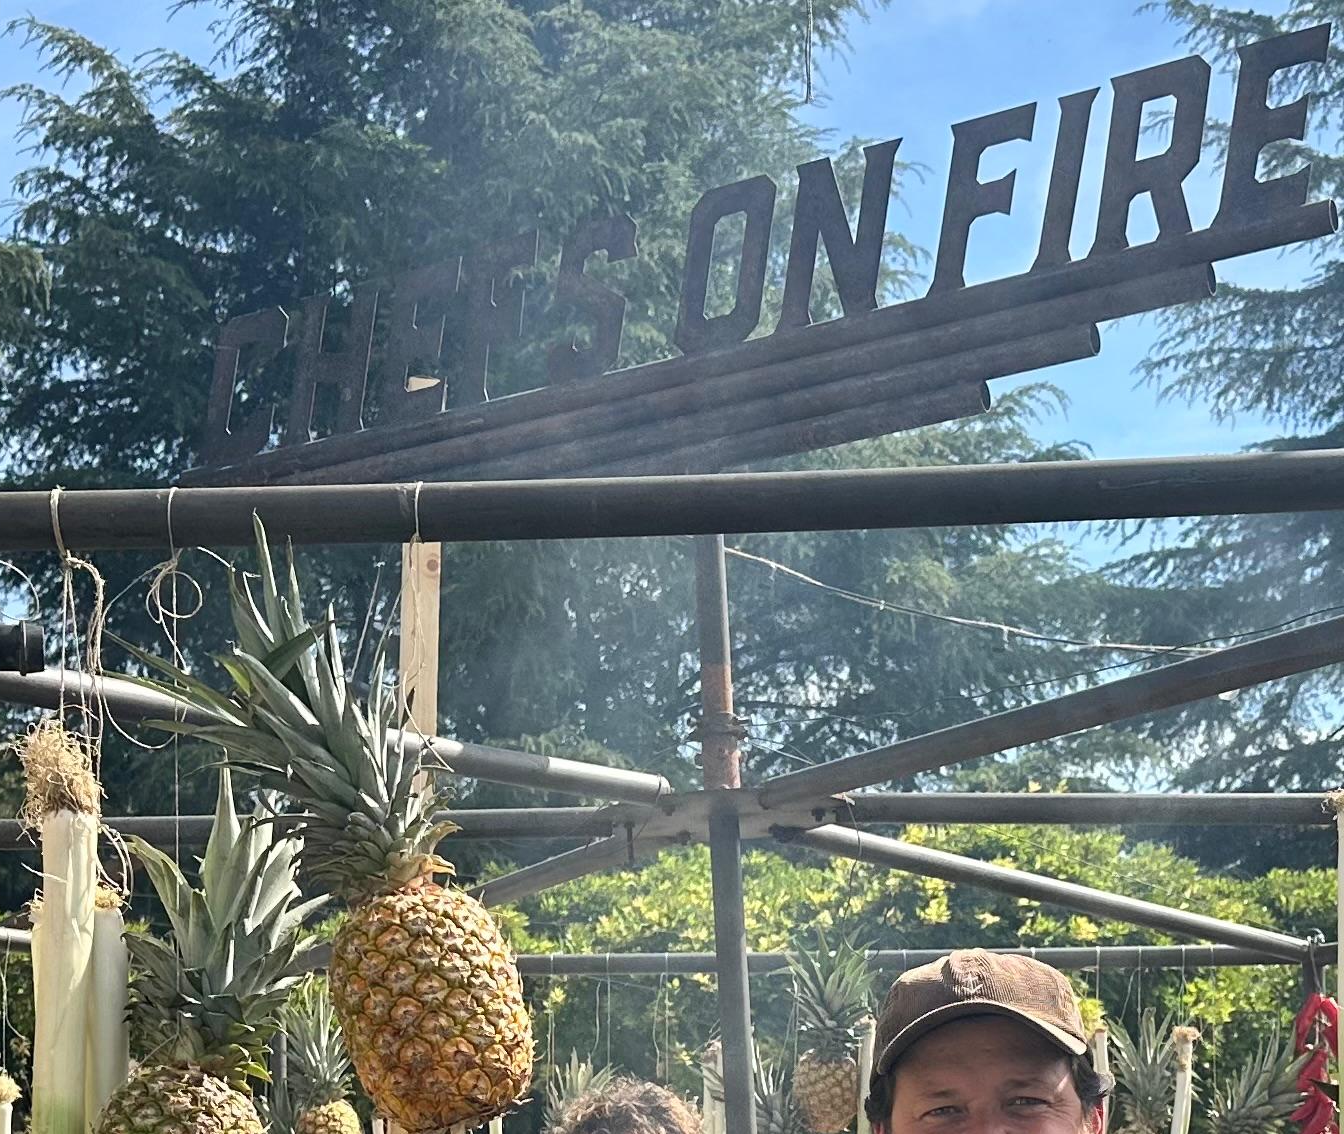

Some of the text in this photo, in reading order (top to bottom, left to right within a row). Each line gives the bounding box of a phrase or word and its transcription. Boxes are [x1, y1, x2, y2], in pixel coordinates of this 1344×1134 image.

[205, 22, 1333, 464] CHEFS ON FIRE
